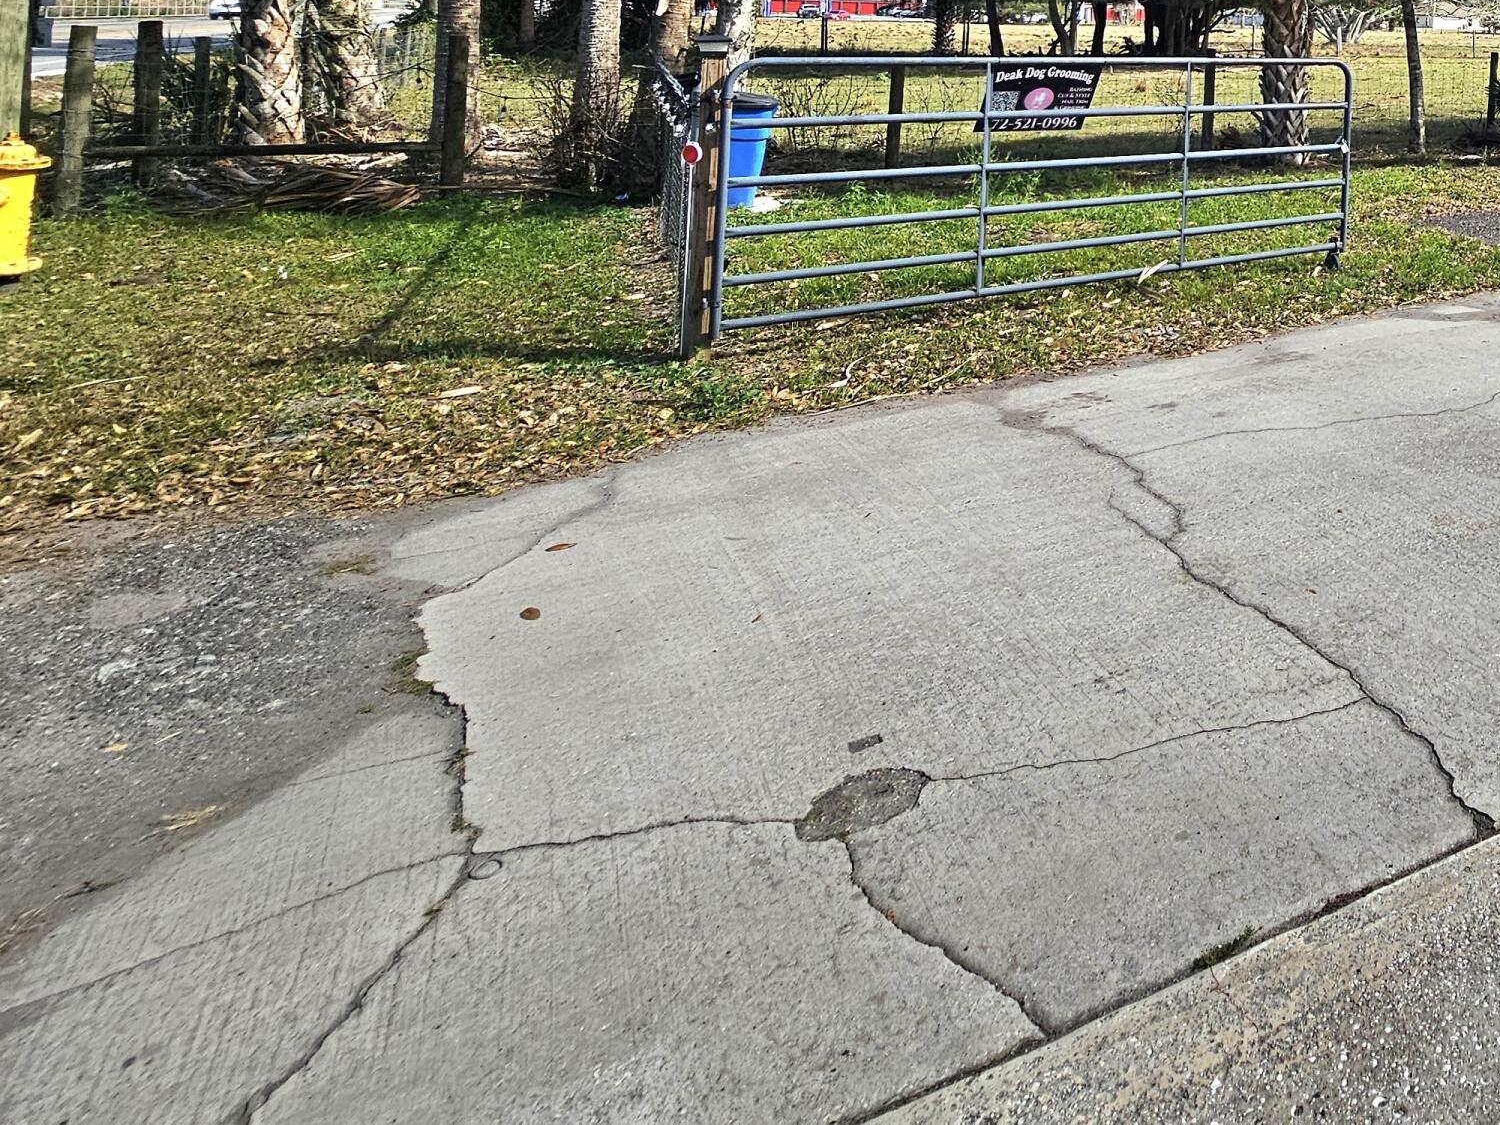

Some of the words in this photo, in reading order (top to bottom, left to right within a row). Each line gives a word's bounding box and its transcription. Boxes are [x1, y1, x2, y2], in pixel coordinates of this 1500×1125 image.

[995, 68, 1024, 83] Deak
[1025, 67, 1047, 80] Dog
[1047, 66, 1095, 85] Grooming
[991, 117, 1077, 130] 72-521-0996
